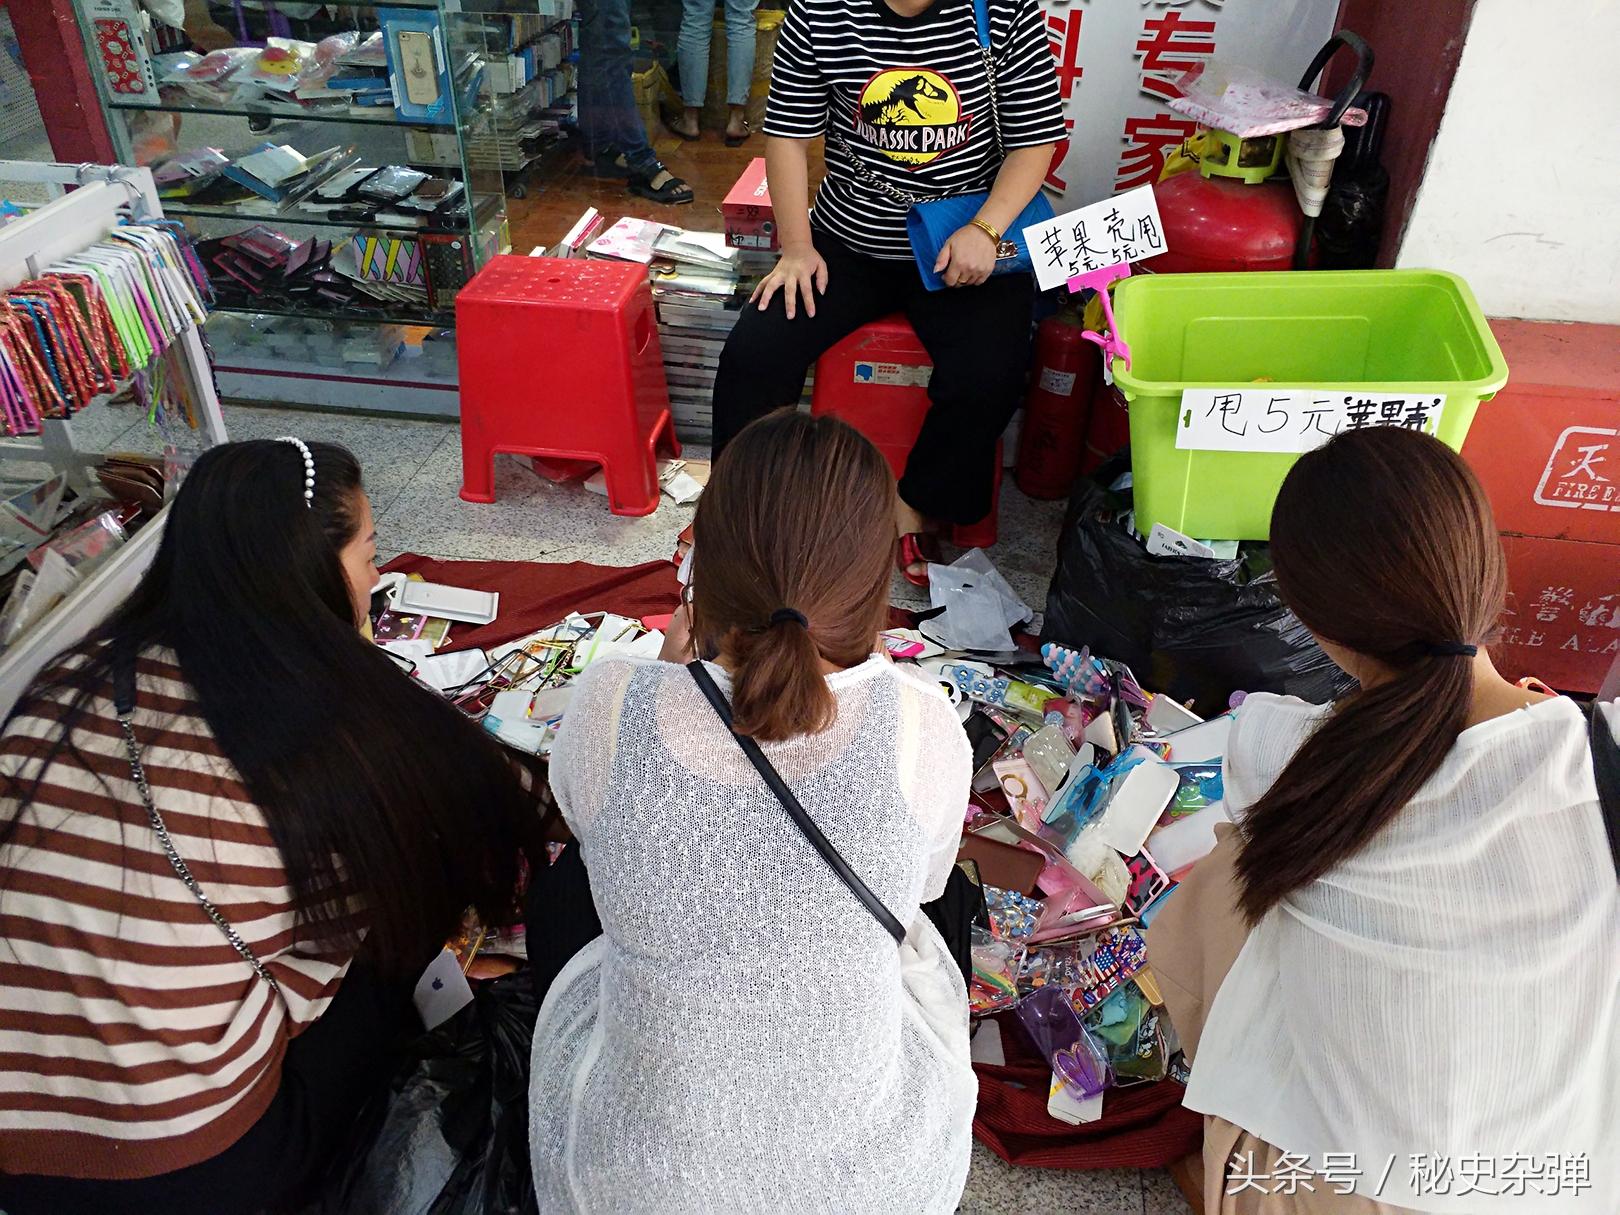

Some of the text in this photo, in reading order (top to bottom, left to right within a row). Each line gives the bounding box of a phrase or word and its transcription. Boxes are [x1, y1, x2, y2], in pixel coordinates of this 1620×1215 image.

[856, 115, 969, 152] JURASSIC PARK
[1552, 481, 1601, 500] FIRE
